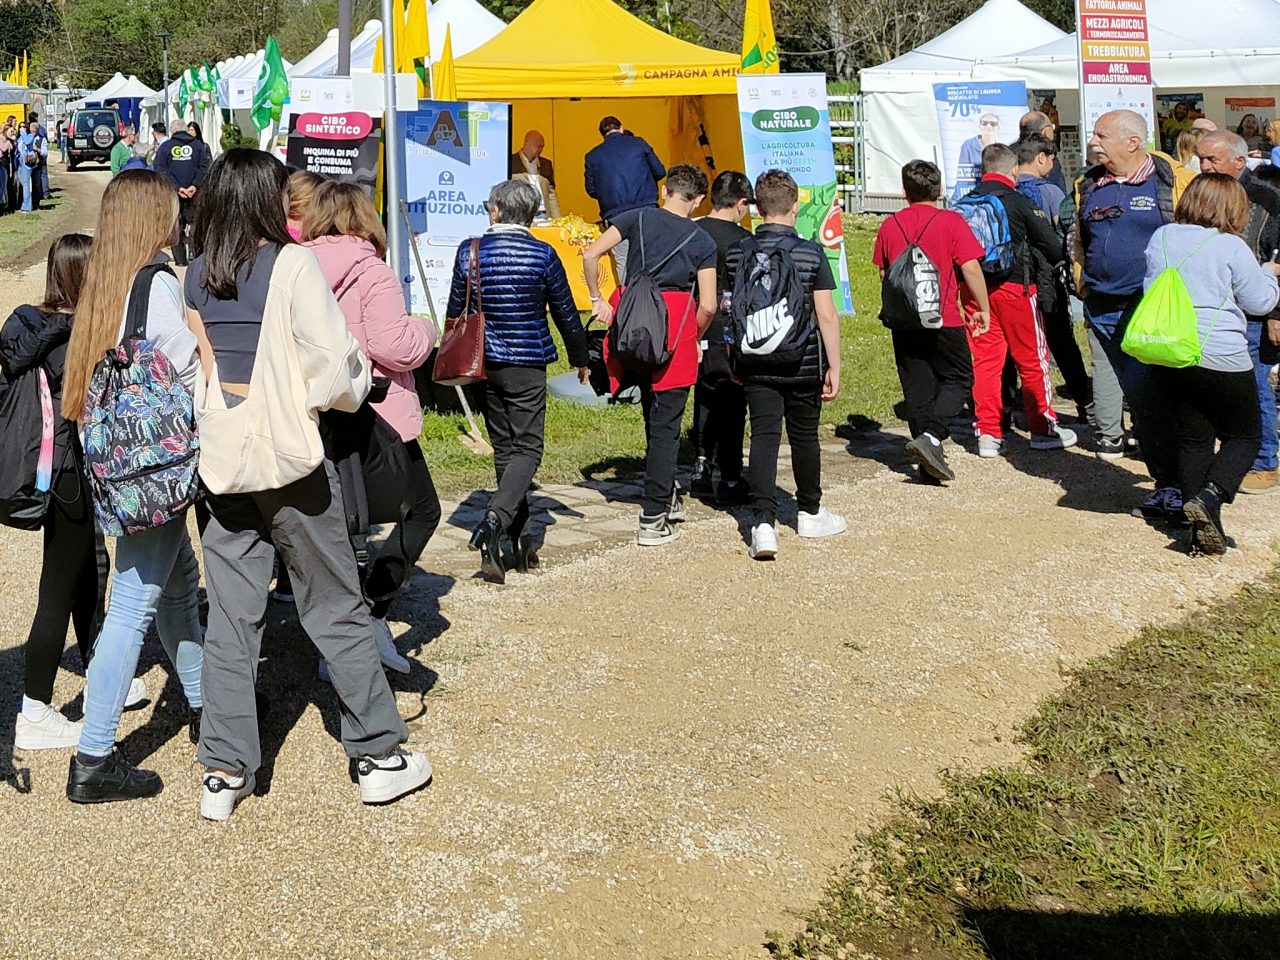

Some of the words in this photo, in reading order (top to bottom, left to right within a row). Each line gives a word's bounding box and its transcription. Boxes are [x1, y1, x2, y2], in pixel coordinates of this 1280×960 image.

[1085, 0, 1116, 10] FATTORIA
[1116, 1, 1142, 11] ANIMALI
[1086, 17, 1109, 29] MEZZI
[1110, 18, 1144, 29] AGRICOLI
[1087, 45, 1146, 57] TREBBIATURA
[1108, 63, 1129, 73] AREA
[643, 68, 708, 80] CAMPAGNA
[1088, 74, 1148, 84] ENOGASTRONOMICA
[773, 111, 797, 119] CIBO
[321, 116, 347, 125] CIBO
[760, 119, 811, 129] NATURALE
[305, 124, 361, 134] SINTETICO
[406, 109, 489, 148] FAT
[171, 146, 192, 158] GO
[303, 147, 335, 157] INQUINA
[336, 149, 345, 157] DI
[346, 147, 359, 157] PIÙ
[314, 157, 352, 166] CONSUMA
[307, 164, 320, 172] PIÙ
[320, 166, 353, 174] ENERGIA
[427, 190, 466, 202] AREA
[406, 202, 487, 216] TITUZIONA
[747, 297, 789, 344] NIKE
